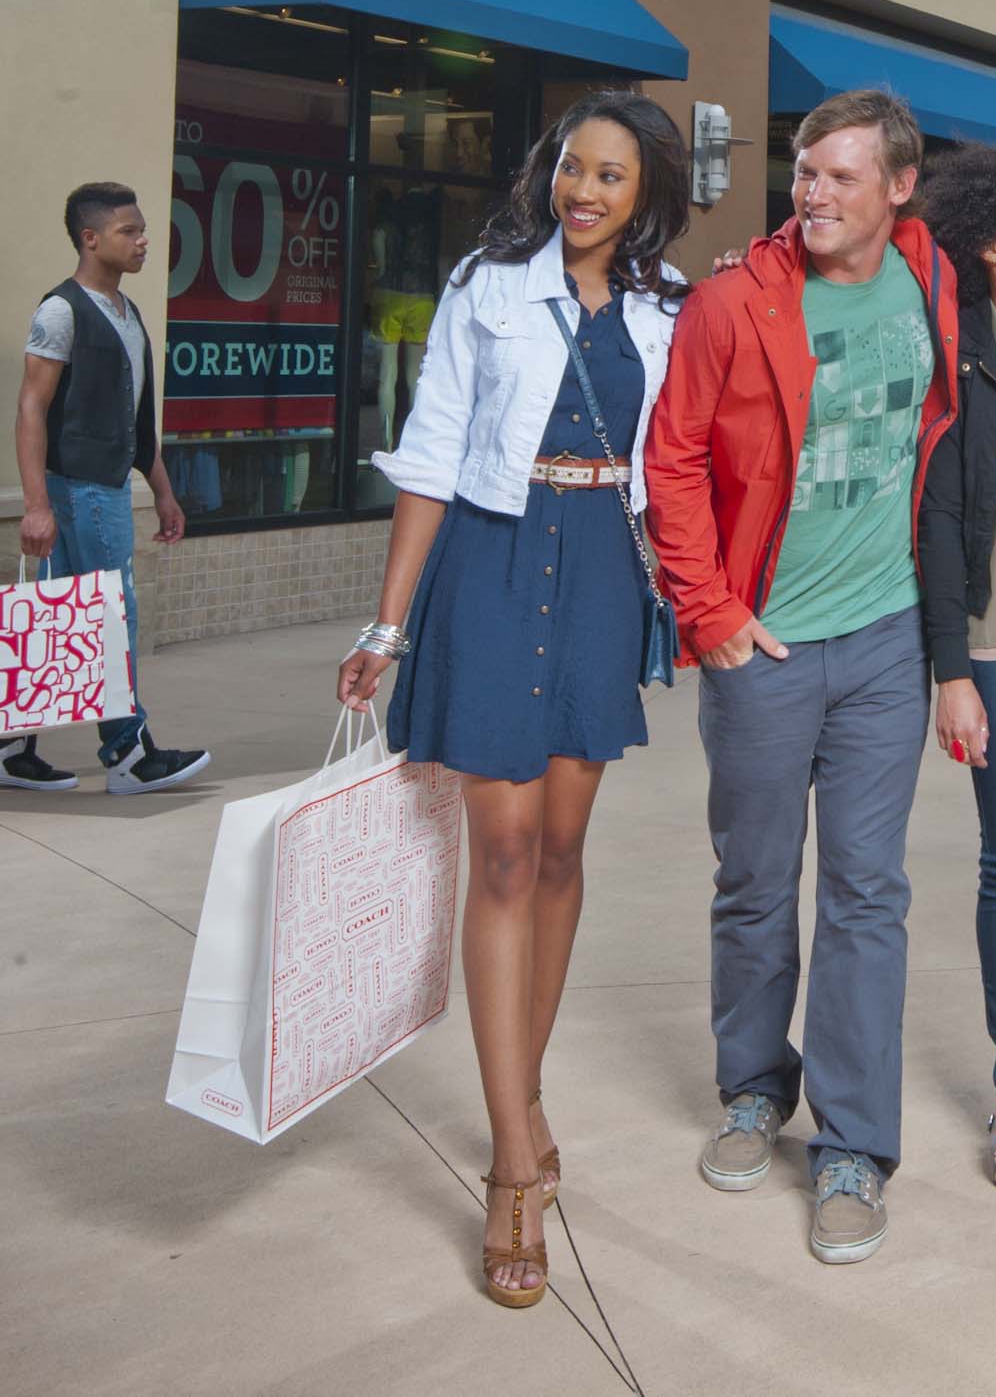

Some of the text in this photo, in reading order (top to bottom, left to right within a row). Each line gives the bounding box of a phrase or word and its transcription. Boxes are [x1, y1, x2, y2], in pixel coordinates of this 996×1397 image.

[288, 235, 338, 267] OFF
[286, 290, 322, 303] PRICES
[287, 275, 337, 289] ORIGINAL
[165, 341, 334, 377] OREWIDE
[346, 905, 390, 934] COACH
